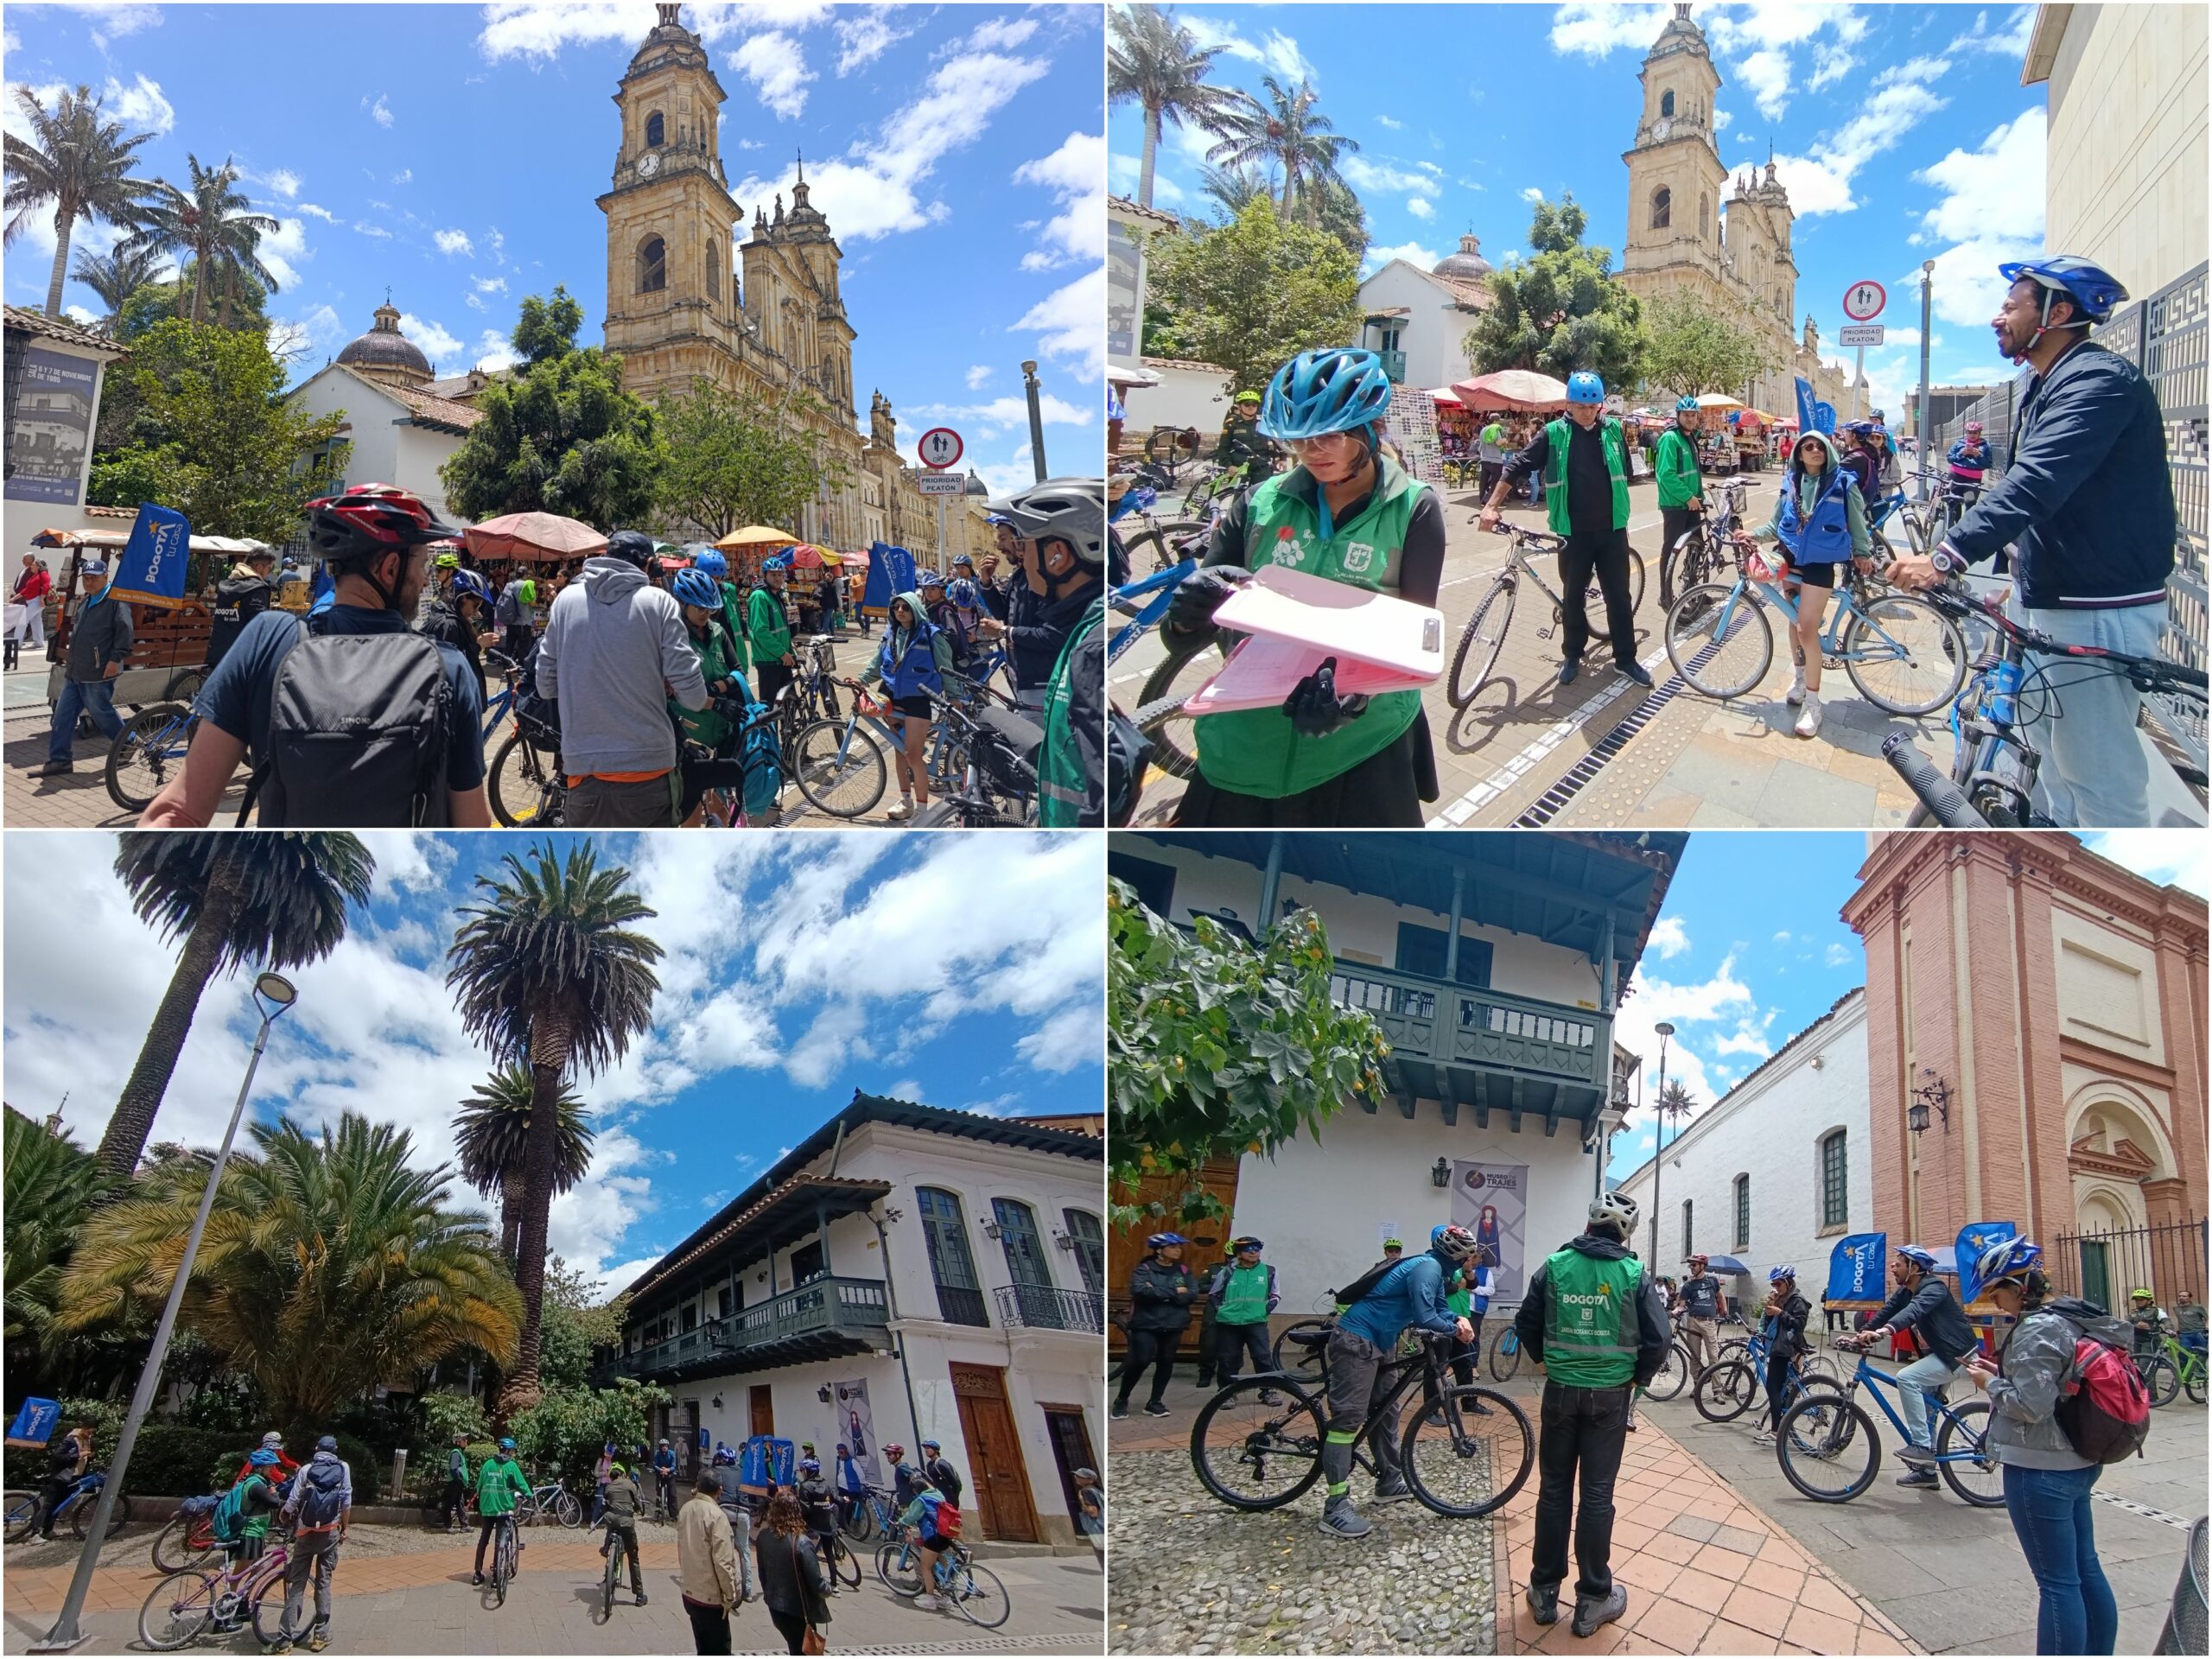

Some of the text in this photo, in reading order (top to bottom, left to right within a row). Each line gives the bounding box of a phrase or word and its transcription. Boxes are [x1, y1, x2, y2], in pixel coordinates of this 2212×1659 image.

[28, 364, 38, 378] SALA
[61, 370, 92, 382] NOVIEMBRE
[47, 374, 61, 384] 1985
[166, 524, 183, 557] tu casa
[1867, 1261, 1875, 1269] tu
